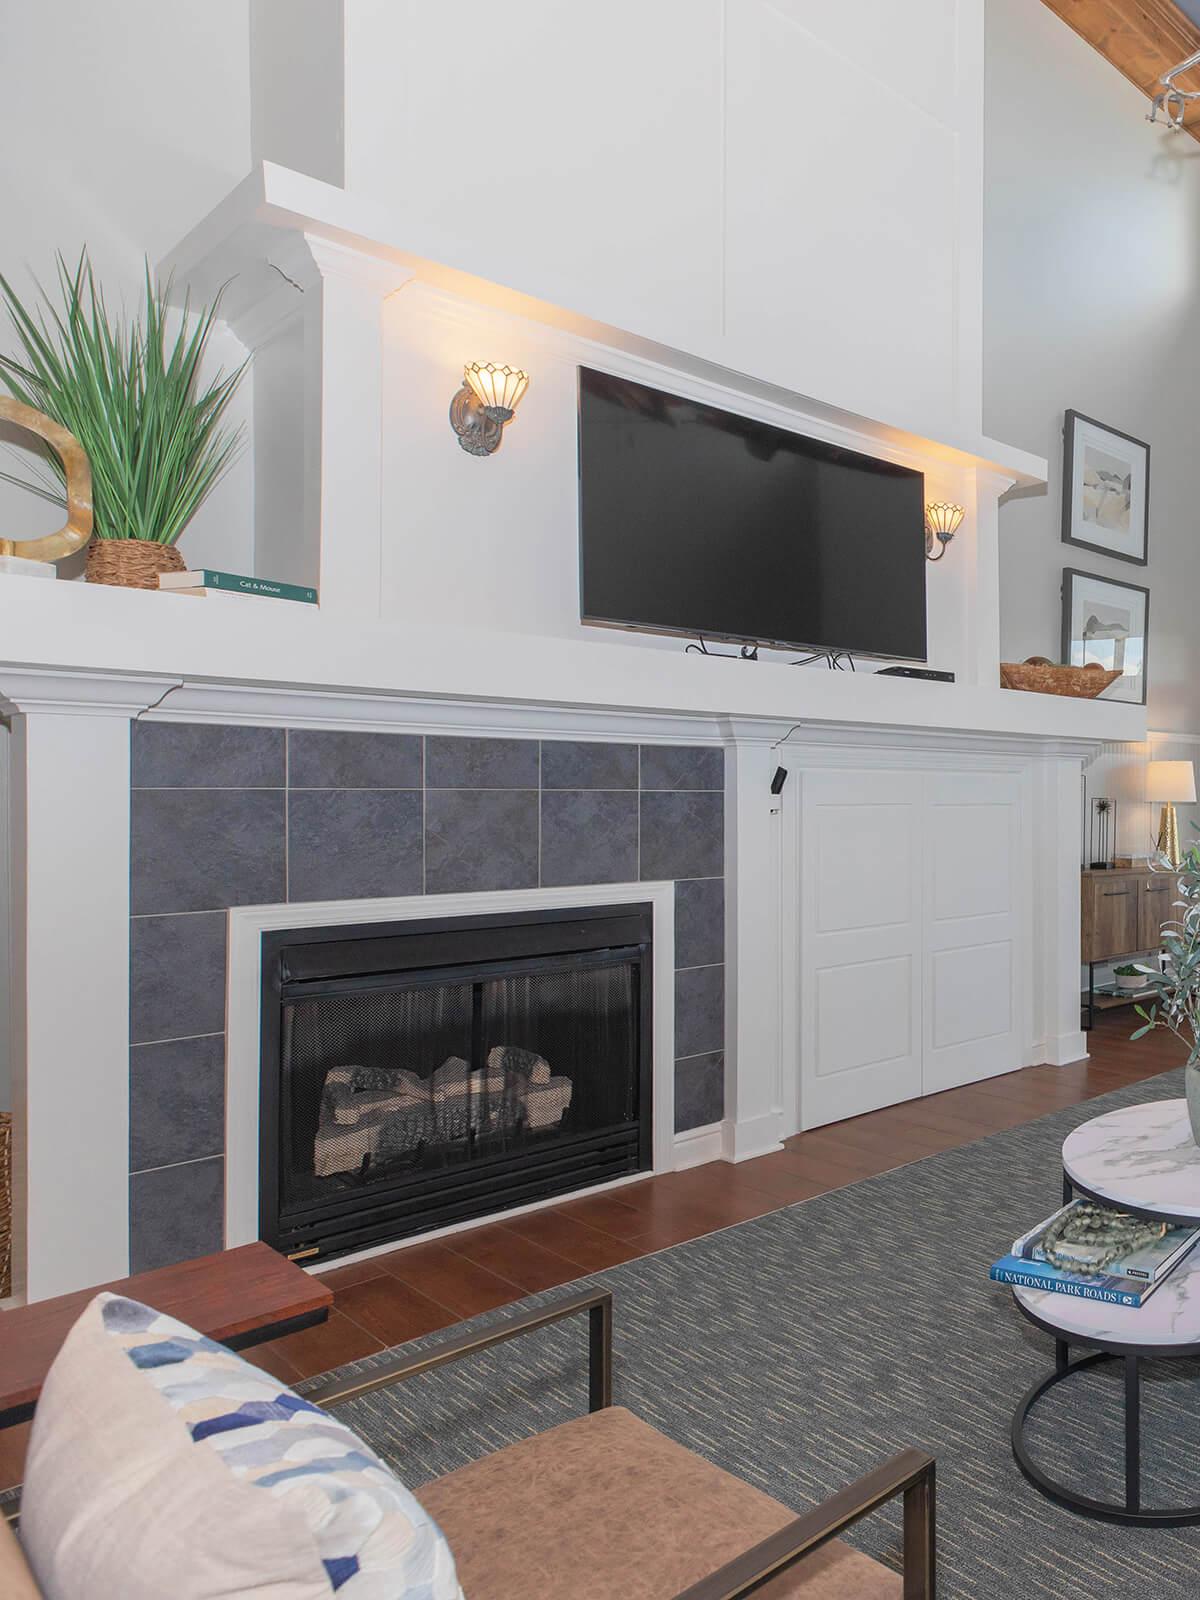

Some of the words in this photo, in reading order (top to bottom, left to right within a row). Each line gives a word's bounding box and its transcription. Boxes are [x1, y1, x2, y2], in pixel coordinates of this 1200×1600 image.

[239, 580, 252, 589] Cat
[1005, 1272, 1053, 1290] NATIONAL
[1055, 1283, 1081, 1296] PARK
[1083, 1288, 1117, 1302] ROADS
